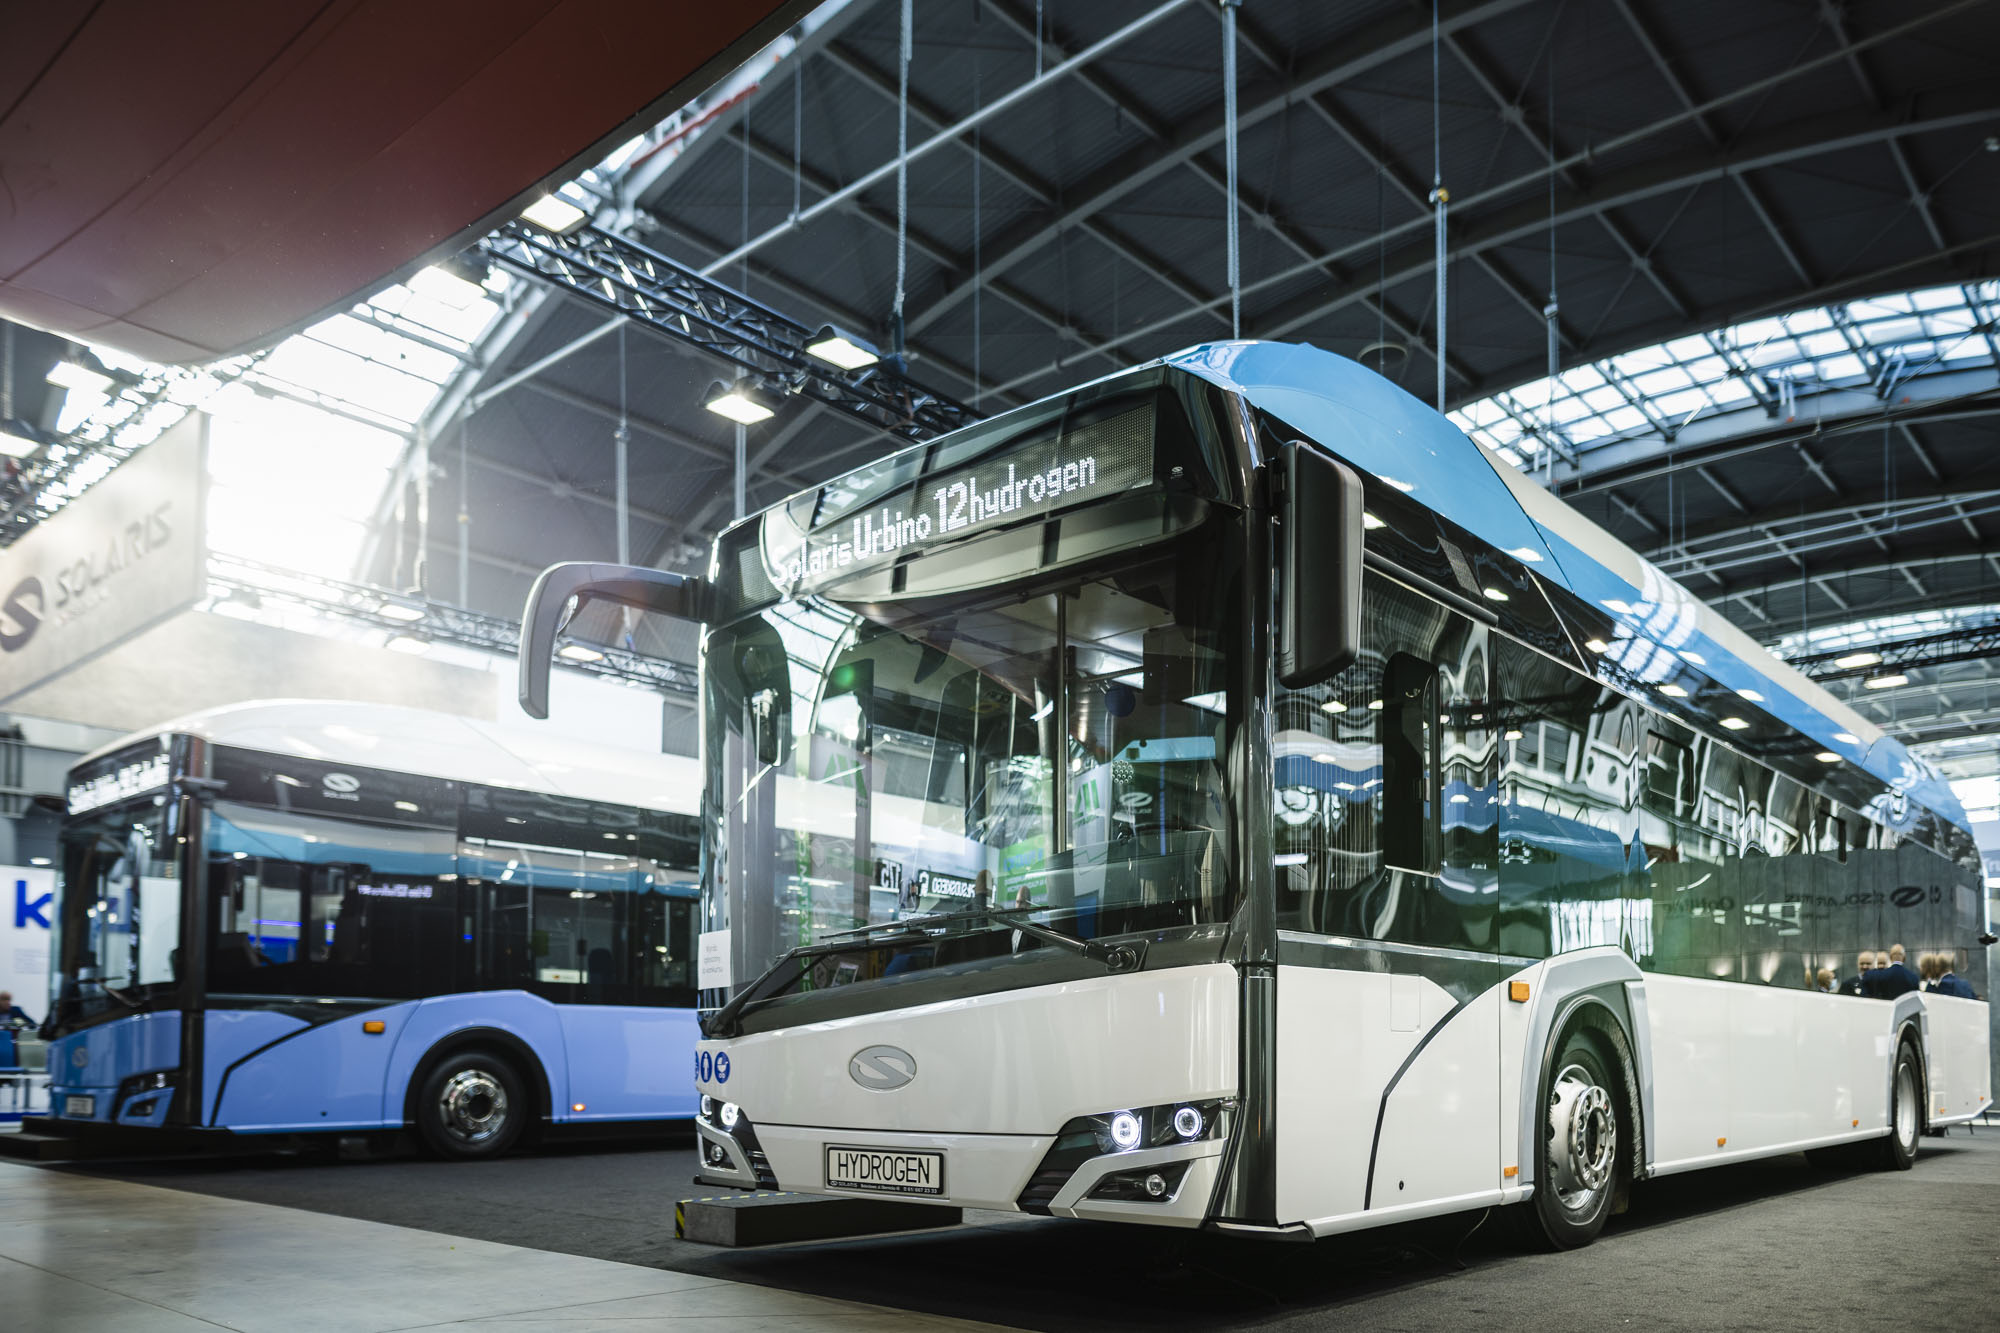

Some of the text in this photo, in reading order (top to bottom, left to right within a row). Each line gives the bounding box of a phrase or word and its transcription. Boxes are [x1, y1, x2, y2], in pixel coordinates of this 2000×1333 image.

[55, 499, 173, 608] SOLARIS
[771, 456, 1096, 583] Solaris Urbino 12 hydrogen
[837, 1152, 930, 1184] HYDROGEN
